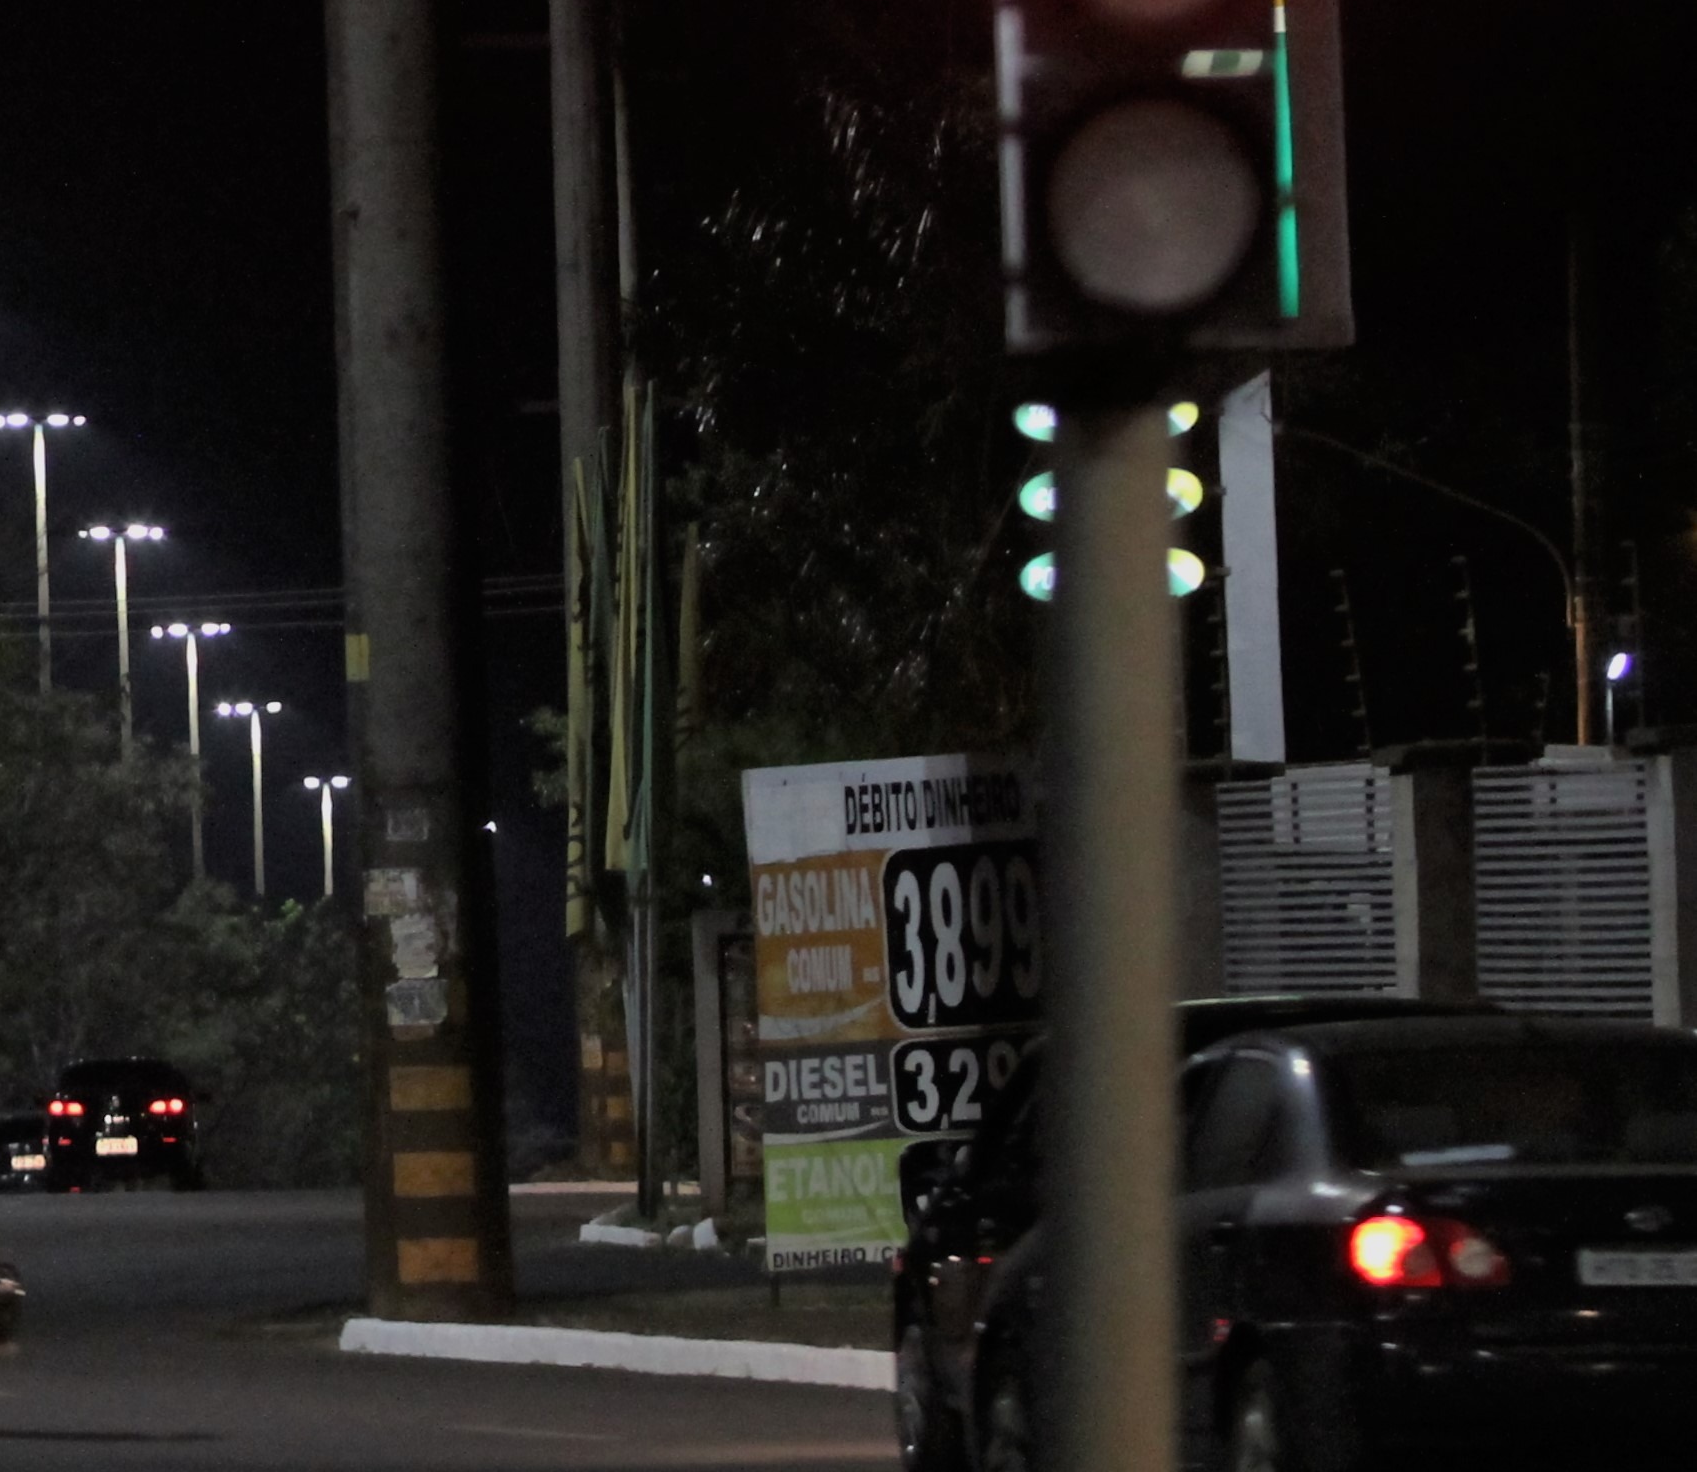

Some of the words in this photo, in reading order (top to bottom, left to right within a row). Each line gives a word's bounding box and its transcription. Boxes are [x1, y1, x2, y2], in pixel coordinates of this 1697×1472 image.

[844, 774, 917, 835] DÉBITO
[922, 772, 1020, 829] DINHEIRO
[757, 866, 876, 937] GASOLINA
[894, 854, 1041, 1025] 3,899
[787, 943, 853, 995] COMUM
[764, 1053, 887, 1103] DIESEL
[796, 1101, 860, 1124] COMUM
[767, 1152, 899, 1203] ETANOL
[772, 1246, 866, 1269] DINHEIRO
